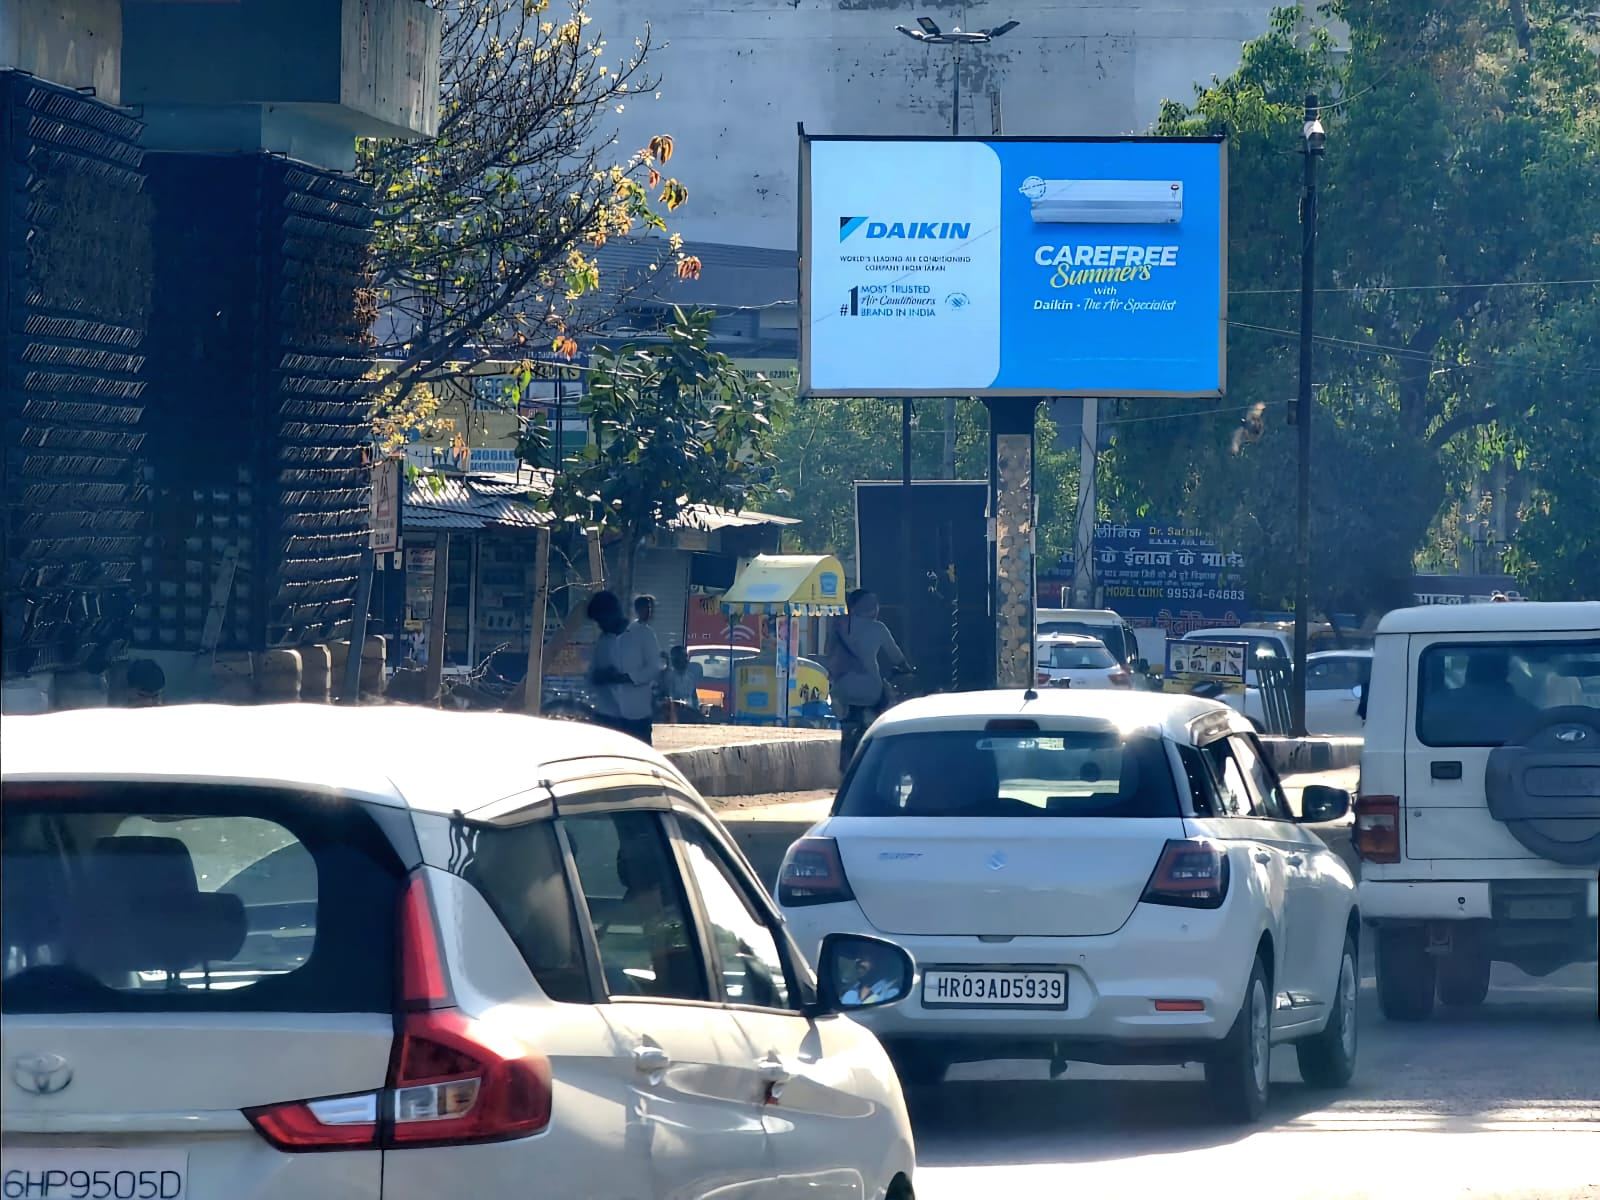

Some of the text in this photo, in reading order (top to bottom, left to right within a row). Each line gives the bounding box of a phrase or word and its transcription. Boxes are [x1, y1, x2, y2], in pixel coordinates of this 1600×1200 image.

[866, 222, 971, 239] DAIKIN
[1034, 245, 1179, 266] CAREFREE
[1050, 263, 1152, 289] Summers
[860, 285, 931, 294] MOST TRUSTED
[1094, 286, 1118, 296] with
[860, 294, 878, 306] Air
[880, 295, 936, 306] Conditioners
[1033, 299, 1073, 311] Daikin
[1083, 297, 1101, 312] The
[1102, 298, 1123, 312] Air
[1124, 298, 1177, 314] Specialist
[860, 308, 937, 317] BRAND IN INDIA
[937, 976, 1062, 999] HR03AD5939
